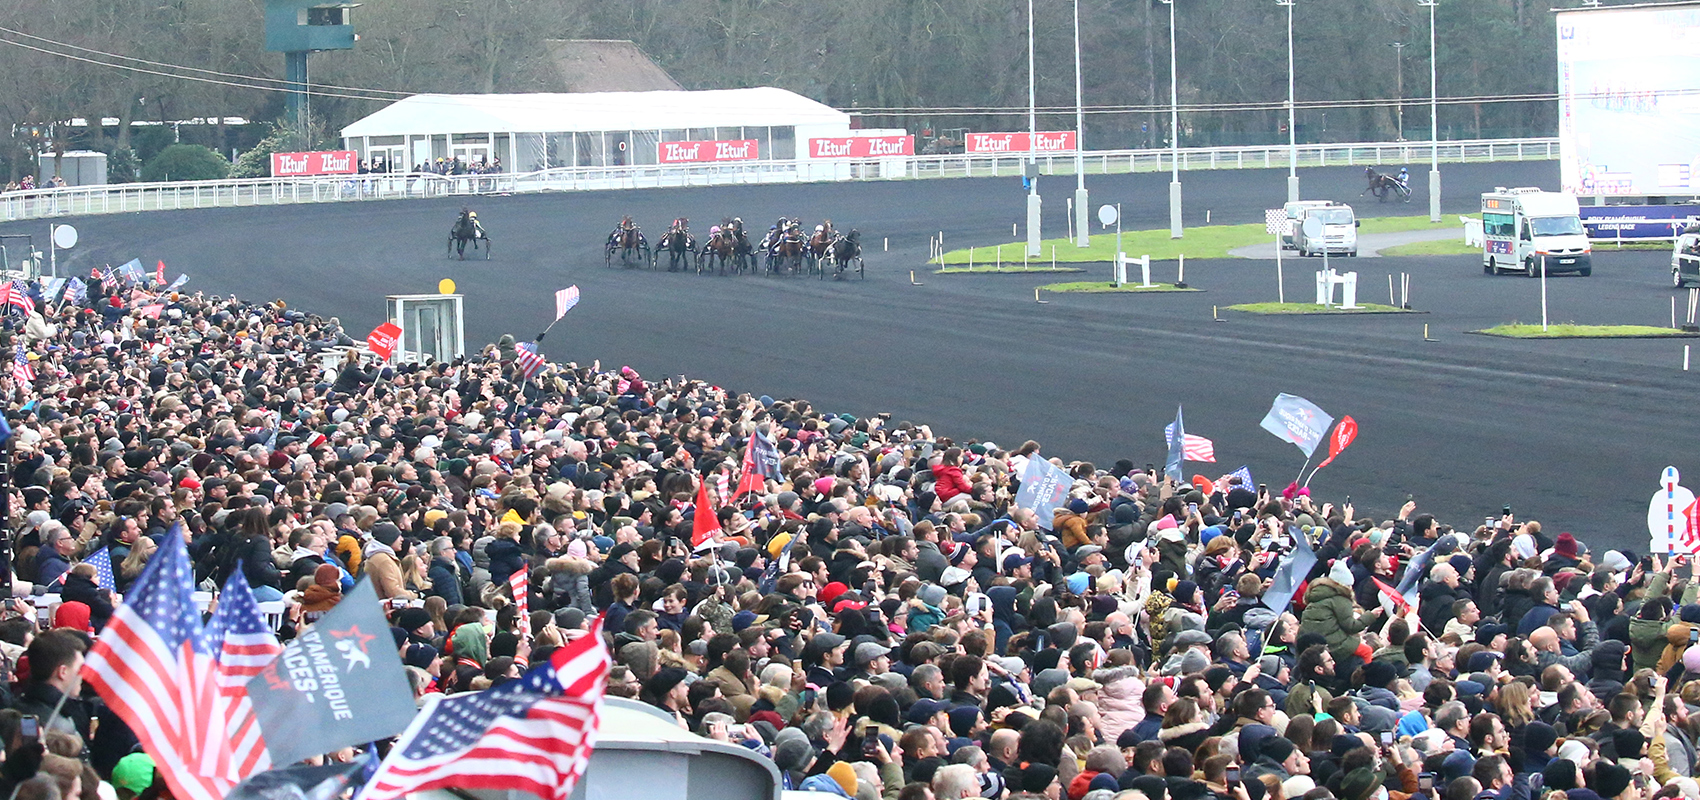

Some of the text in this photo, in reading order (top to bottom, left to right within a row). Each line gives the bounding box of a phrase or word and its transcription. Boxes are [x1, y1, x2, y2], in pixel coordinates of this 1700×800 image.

[665, 141, 750, 161] ZEturf ZEturf
[816, 137, 906, 156] ZEturf ZEturf
[974, 134, 1013, 151] ZEturf
[279, 153, 351, 174] ZEturf ZEturf
